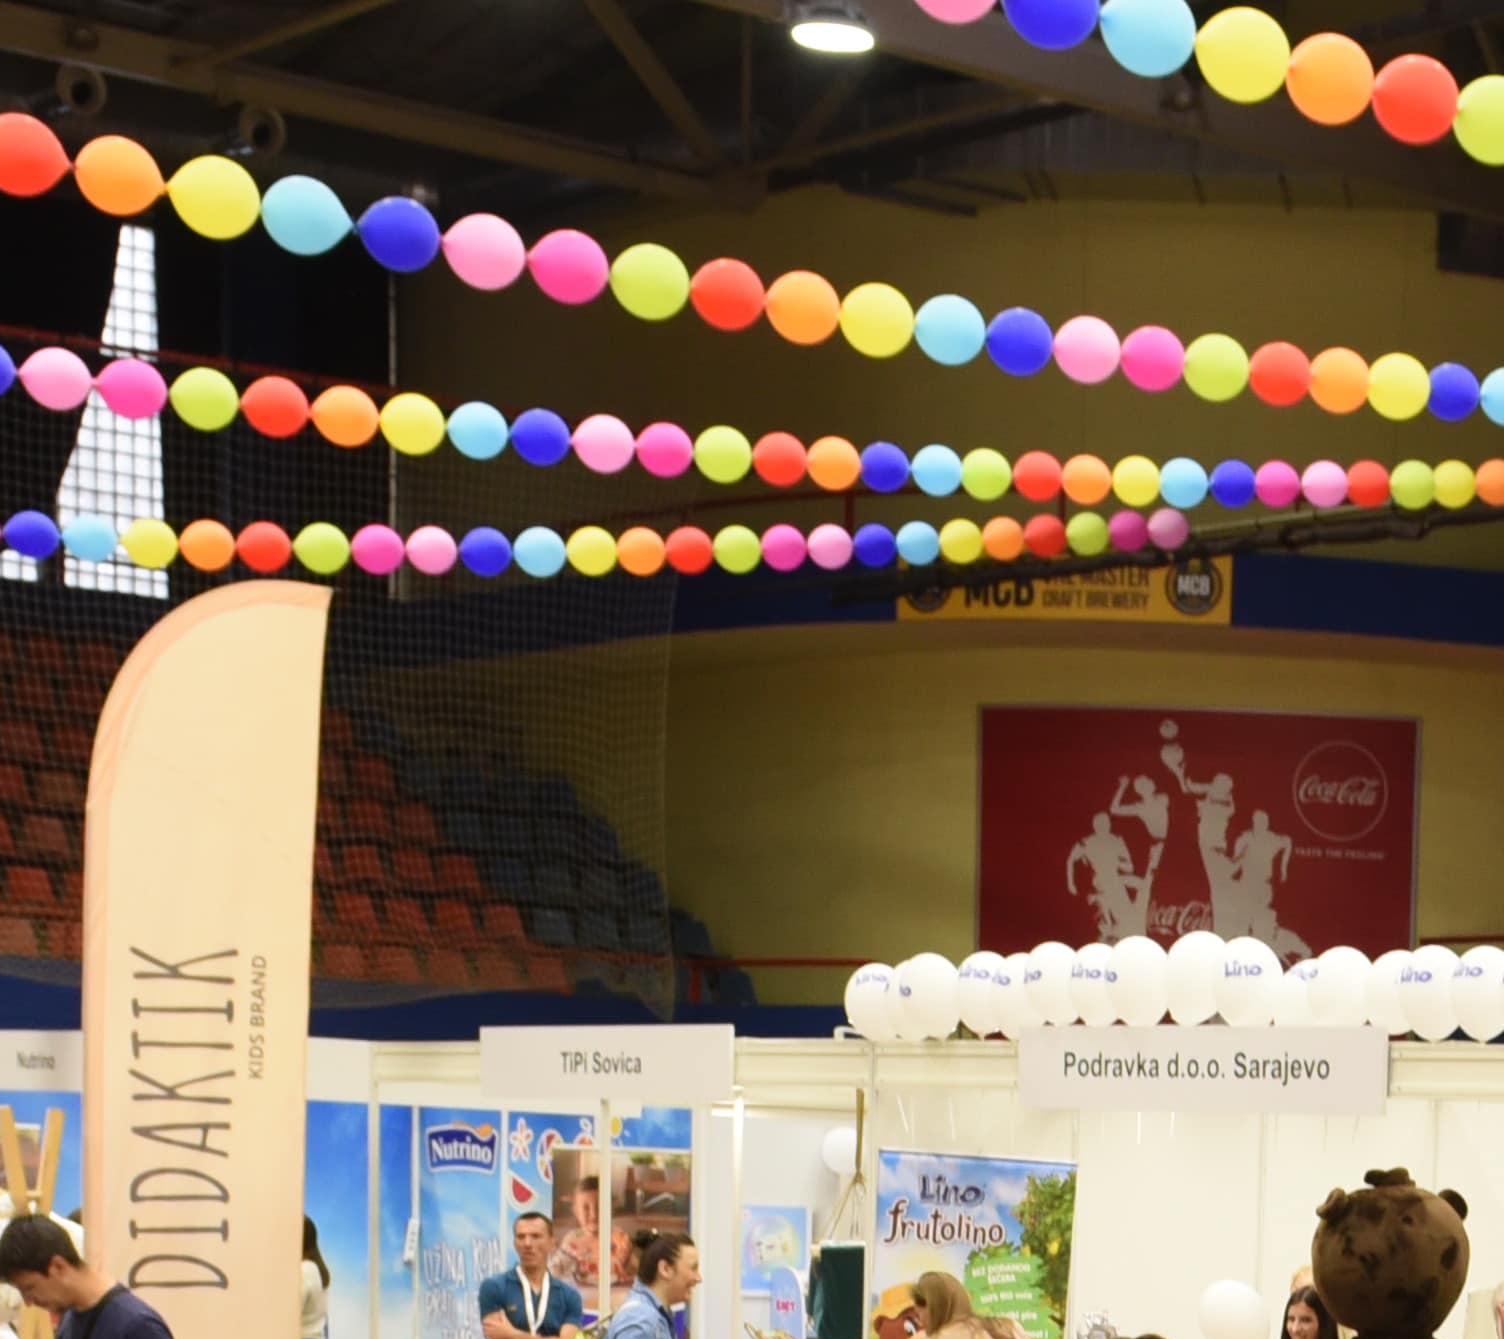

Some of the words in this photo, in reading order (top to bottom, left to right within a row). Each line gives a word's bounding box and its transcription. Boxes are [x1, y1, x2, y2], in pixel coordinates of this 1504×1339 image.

[1177, 574, 1212, 597] MCB
[1225, 959, 1262, 977] Lino
[250, 954, 268, 1030] BRAND
[248, 1035, 264, 1080] KIDS
[561, 1051, 587, 1073] TiPi
[591, 1052, 642, 1076] Sovica
[1063, 1051, 1160, 1078] Podravka
[1166, 1053, 1226, 1078] d.o.o.
[1234, 1053, 1331, 1088] Sarajevo
[128, 945, 239, 1290] DIDAKTIK
[431, 1139, 493, 1163] Nutrino
[920, 1174, 987, 1208] Lino
[884, 1198, 1006, 1248] frutolino
